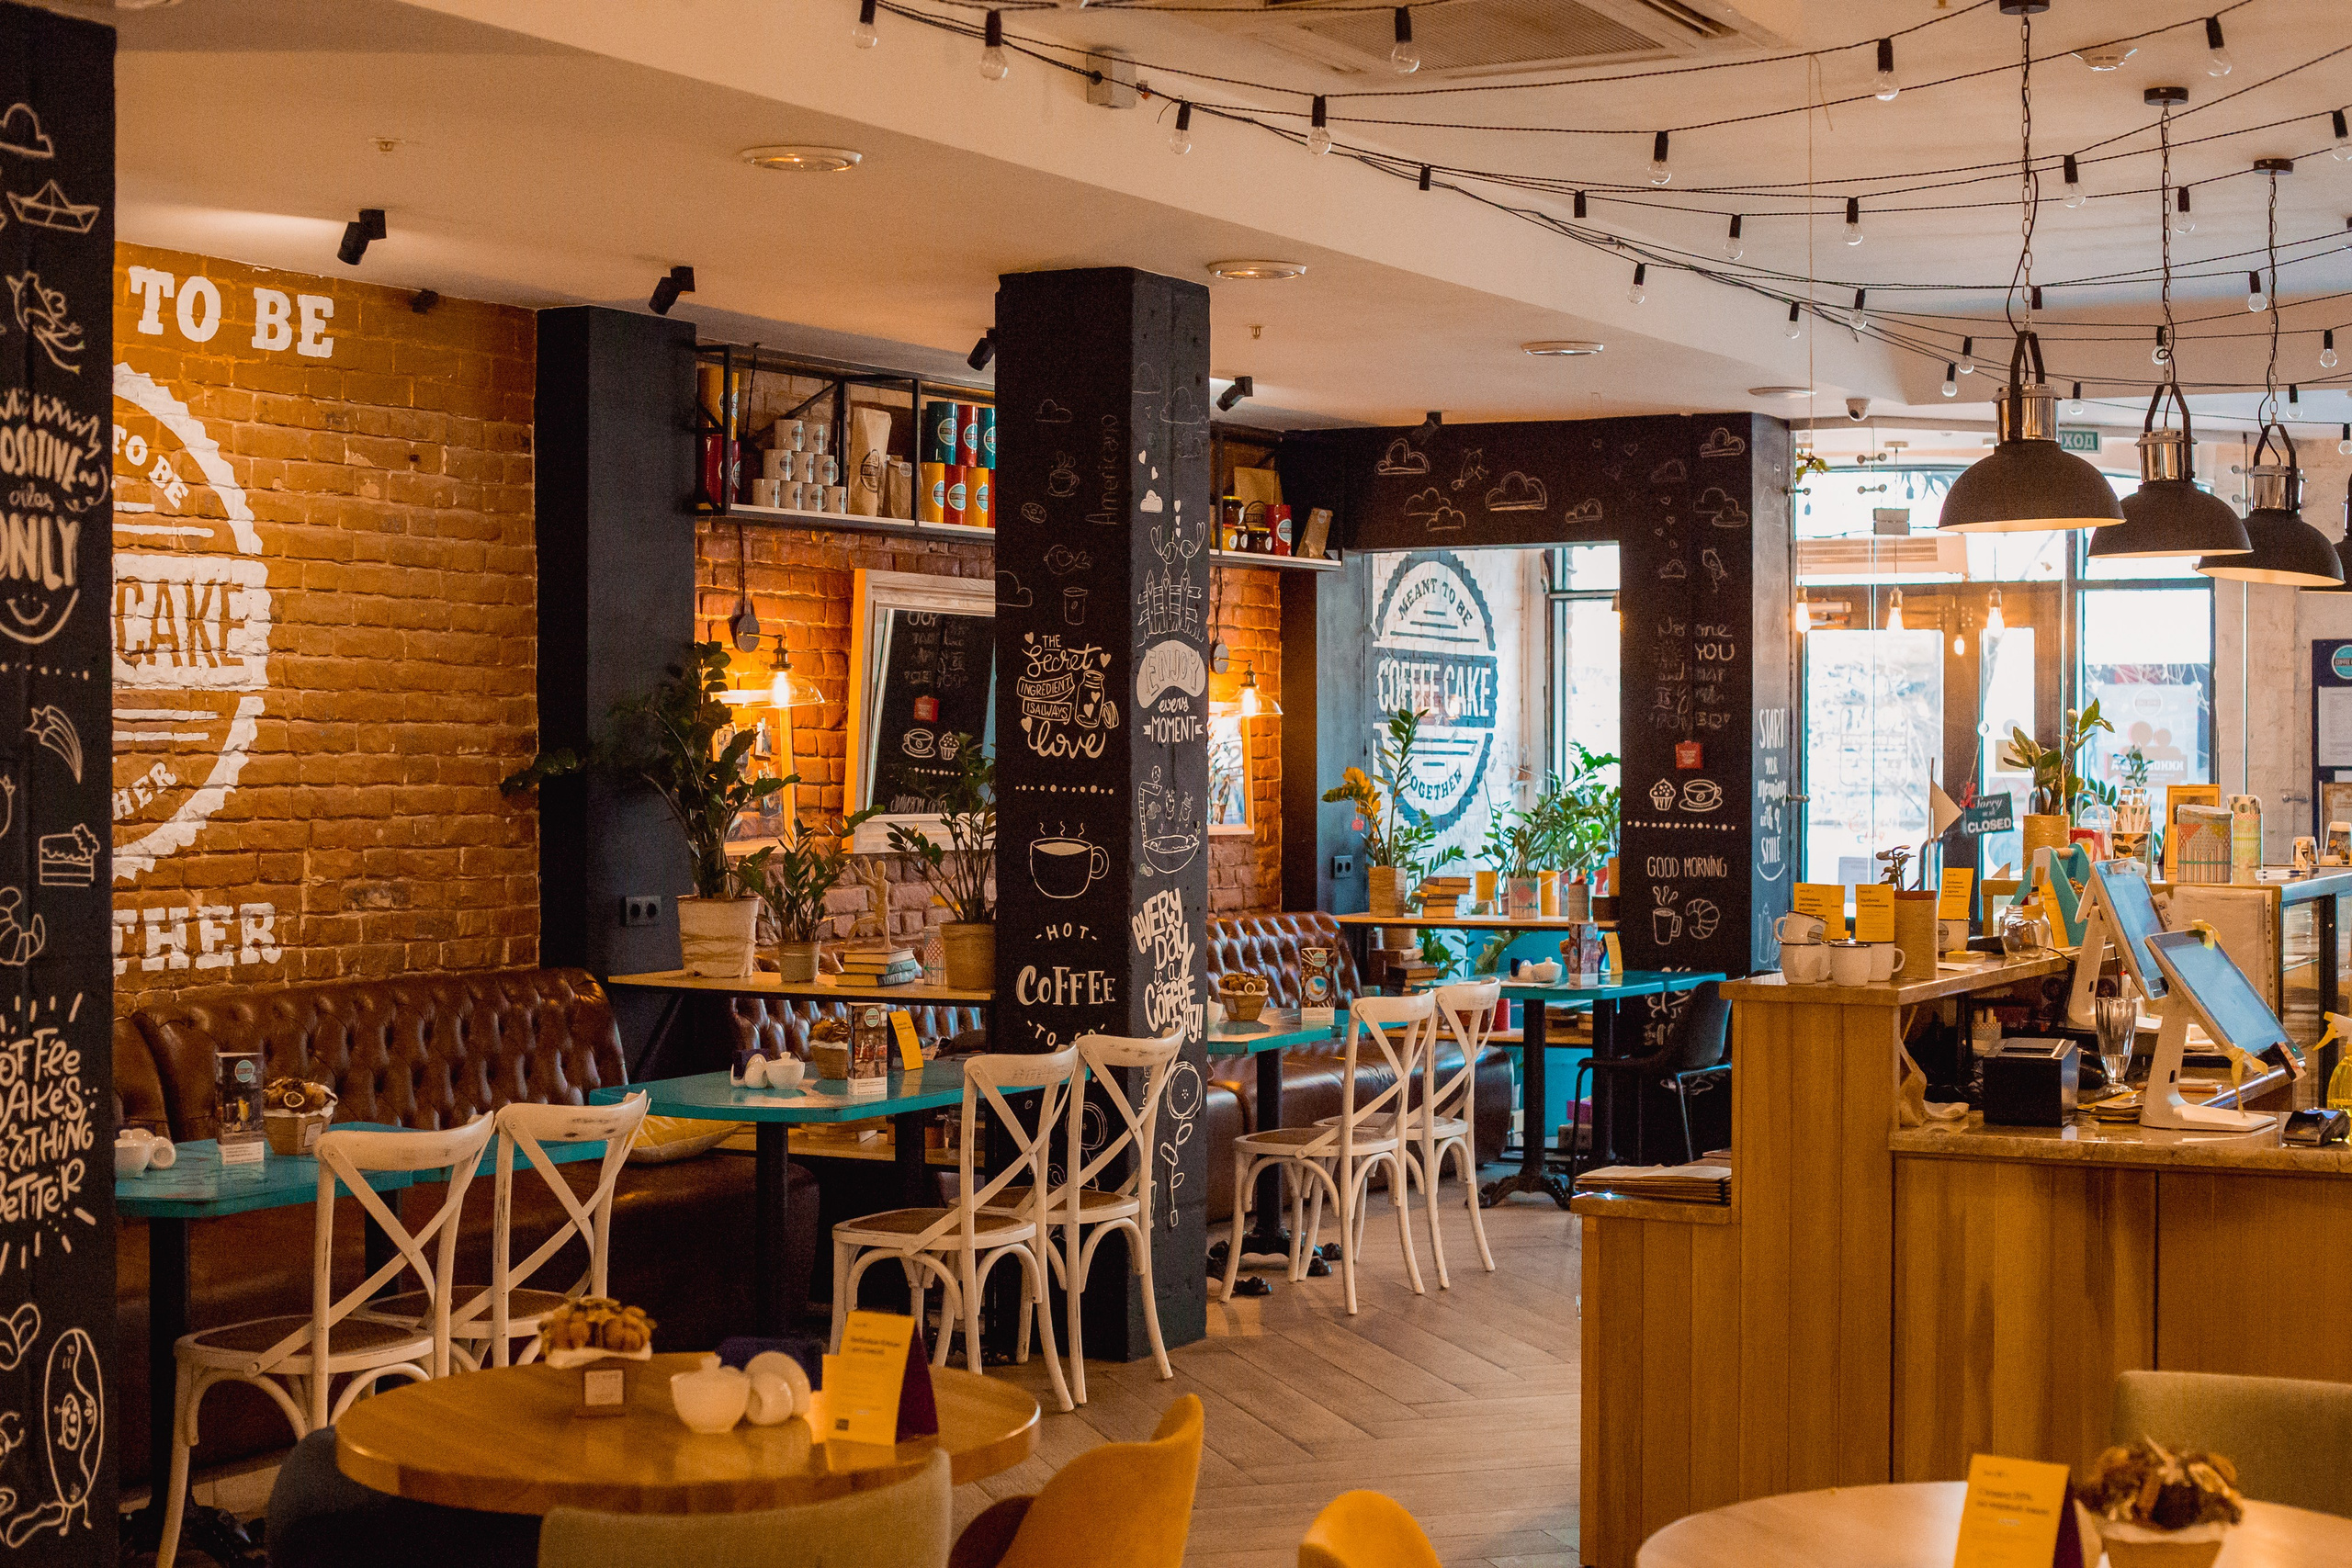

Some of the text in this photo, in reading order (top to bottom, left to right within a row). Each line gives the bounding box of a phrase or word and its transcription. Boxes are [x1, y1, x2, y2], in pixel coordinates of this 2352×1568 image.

[129, 265, 334, 358] TO BE
[2058, 433, 2096, 449] ХОД
[0, 424, 84, 493] OSITIVE
[113, 424, 189, 509] TO BE
[1398, 578, 1474, 627] MEANT TO BE
[117, 579, 246, 669] CAKE
[1041, 635, 1061, 648] THE
[1694, 641, 1736, 661] YOU
[1022, 644, 1102, 678] Secret
[1147, 649, 1200, 696] ENJOY
[1020, 678, 1072, 696] INGREDIENT
[1376, 659, 1492, 717] COFFEE CAKE
[1159, 695, 1189, 713] every
[1027, 720, 1105, 759] love
[1151, 716, 1197, 743] MOMENT
[1758, 708, 1786, 750] START
[113, 761, 177, 820] HER
[1967, 817, 2012, 834] CLOSED
[1647, 854, 1727, 878] GOOD MORNING
[1761, 836, 1781, 865] SMILE
[1046, 923, 1089, 941] HOT
[1035, 1023, 1057, 1046] TO
